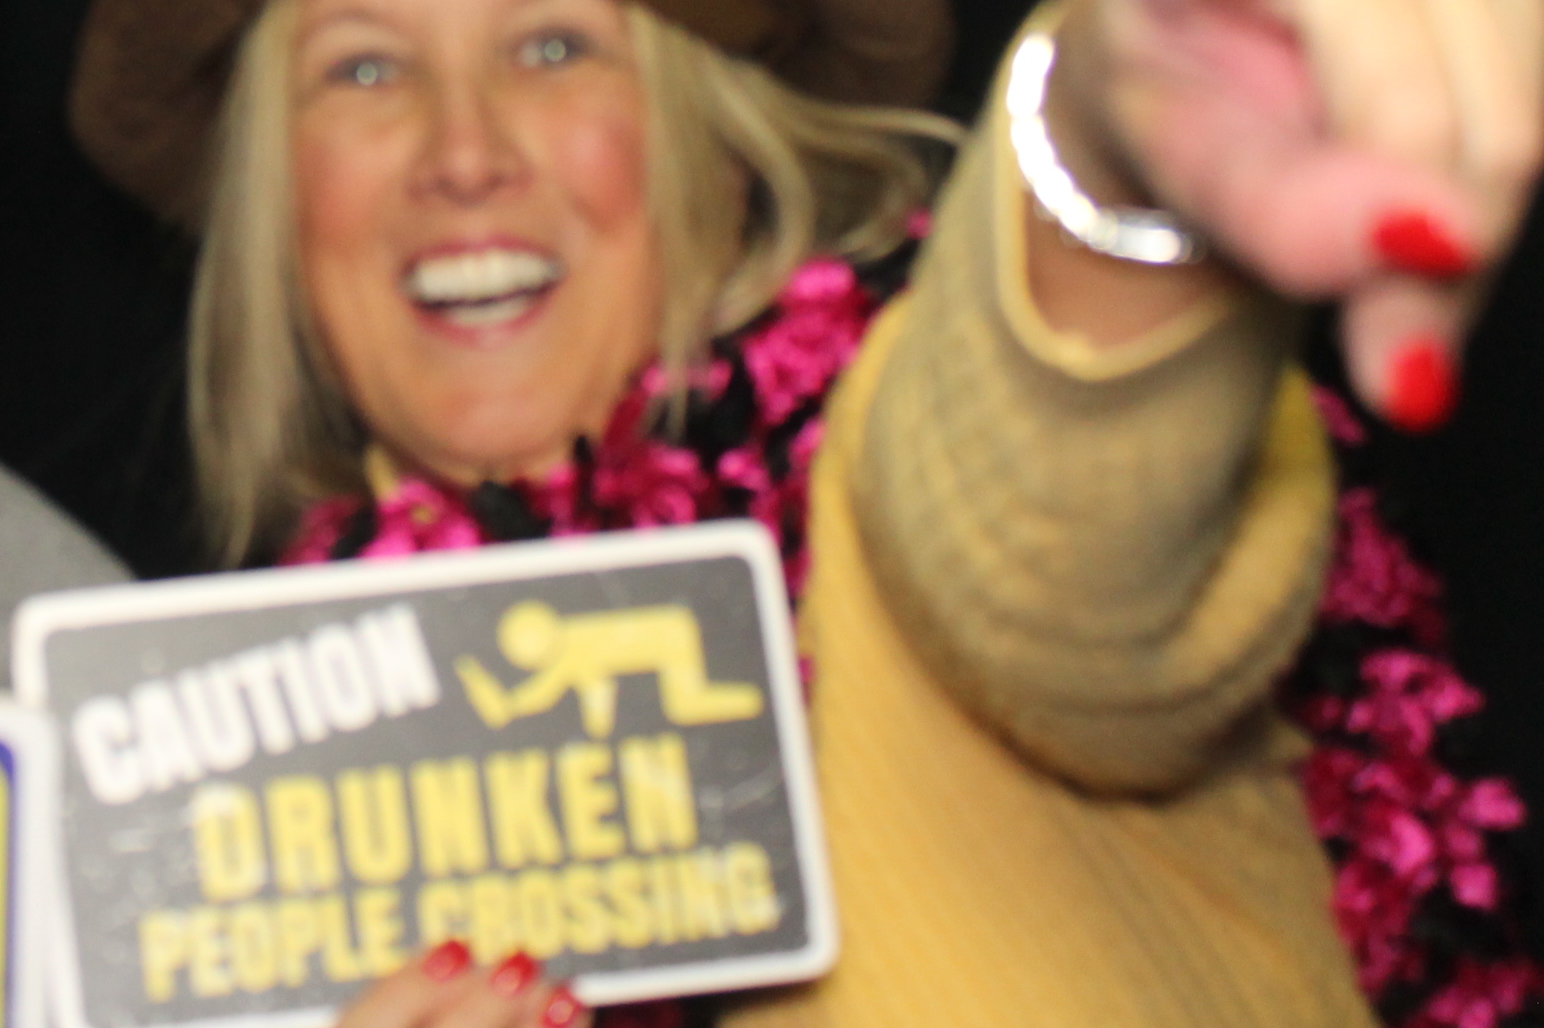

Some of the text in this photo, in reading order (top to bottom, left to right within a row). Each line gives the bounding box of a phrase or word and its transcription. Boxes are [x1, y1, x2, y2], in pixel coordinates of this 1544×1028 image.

[74, 604, 440, 804] CAUTION
[194, 734, 698, 902] DRUNKEN
[140, 842, 780, 1002] PEOPLE CROSSING
